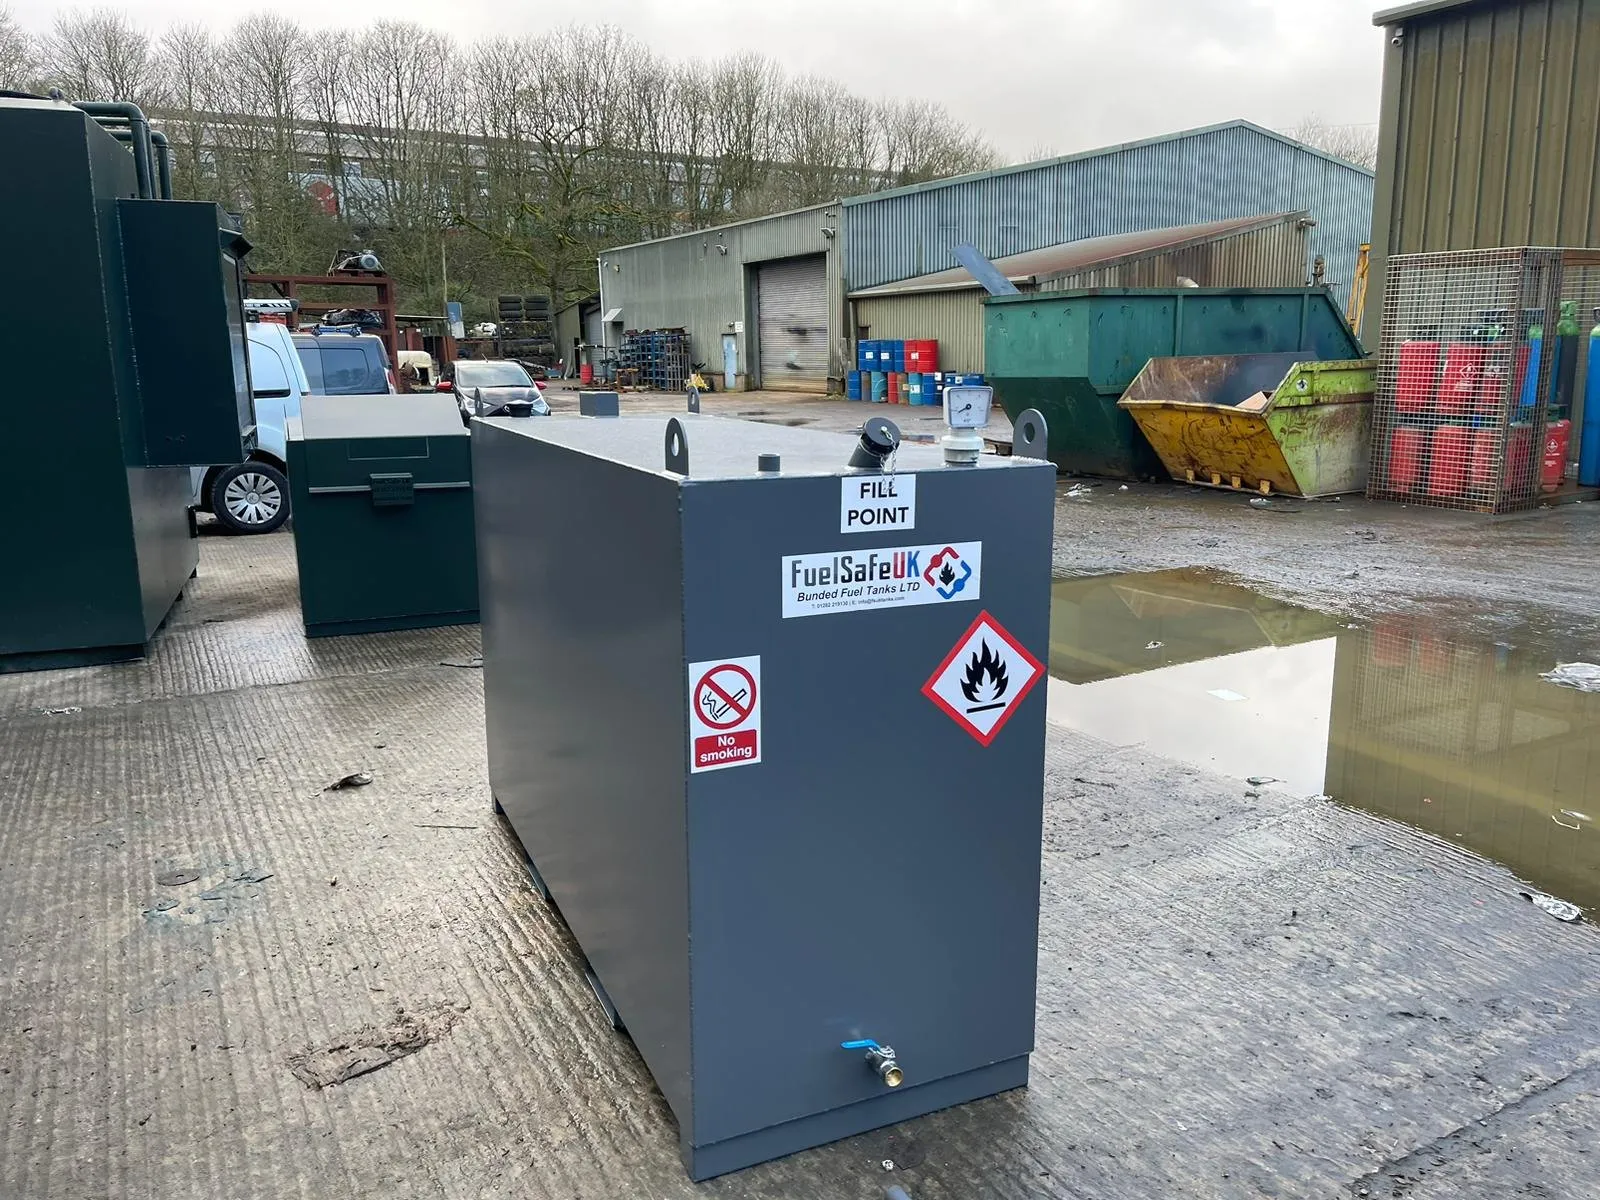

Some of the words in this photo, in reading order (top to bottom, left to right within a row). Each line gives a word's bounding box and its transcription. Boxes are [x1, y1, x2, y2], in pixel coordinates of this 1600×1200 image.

[860, 481, 898, 499] FILL
[847, 507, 909, 526] POINT
[791, 550, 921, 588] FuelSafeUK
[797, 587, 838, 602] Bunded
[840, 585, 864, 598] Fuel
[867, 584, 897, 596] Tanks
[899, 581, 921, 592] LTD
[717, 735, 735, 747] No
[700, 746, 752, 762] smoking
